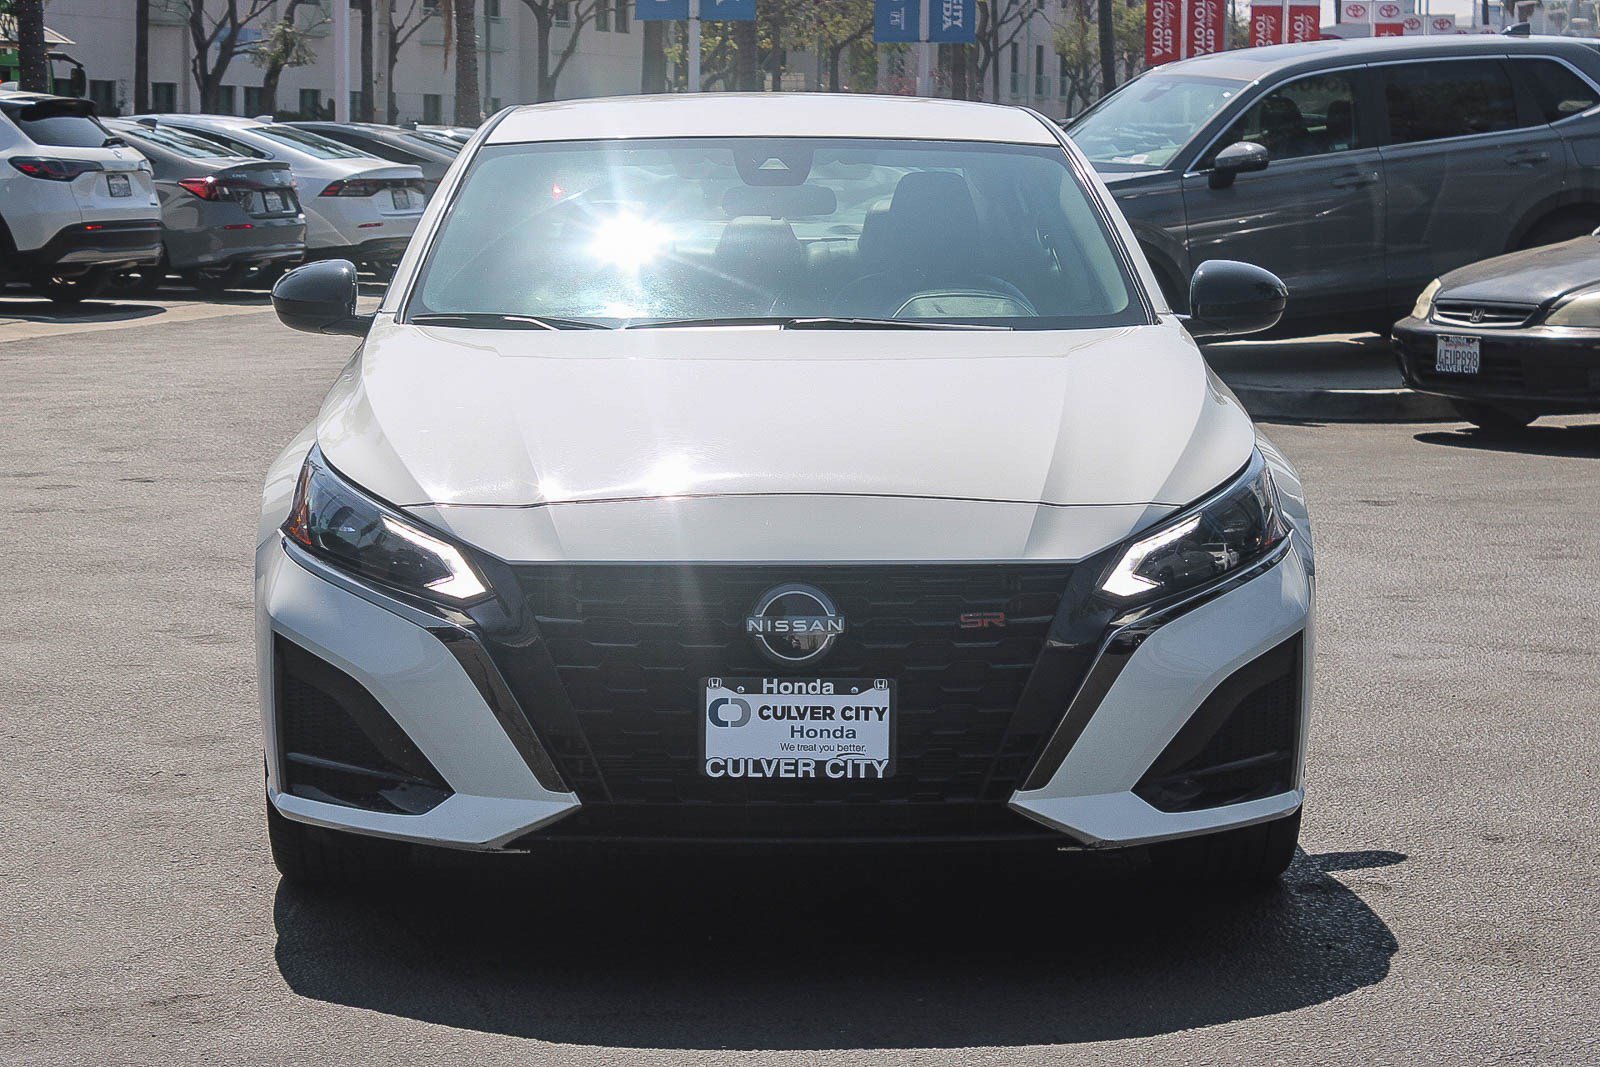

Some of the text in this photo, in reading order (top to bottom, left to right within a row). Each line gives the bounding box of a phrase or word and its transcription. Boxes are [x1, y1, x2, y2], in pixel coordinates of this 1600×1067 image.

[1152, 0, 1164, 57] TOYOTA
[1194, 0, 1206, 56] TOYOTA
[1164, 28, 1173, 54] CITY
[1206, 28, 1215, 53] CITY
[747, 618, 845, 633] NISSAN
[960, 612, 1006, 629] SR
[762, 678, 835, 695] Honda
[758, 705, 888, 722] CULVER CITY
[790, 726, 857, 739] Honda
[780, 743, 867, 755] We treat you better.
[705, 757, 889, 779] CULVER CITY
